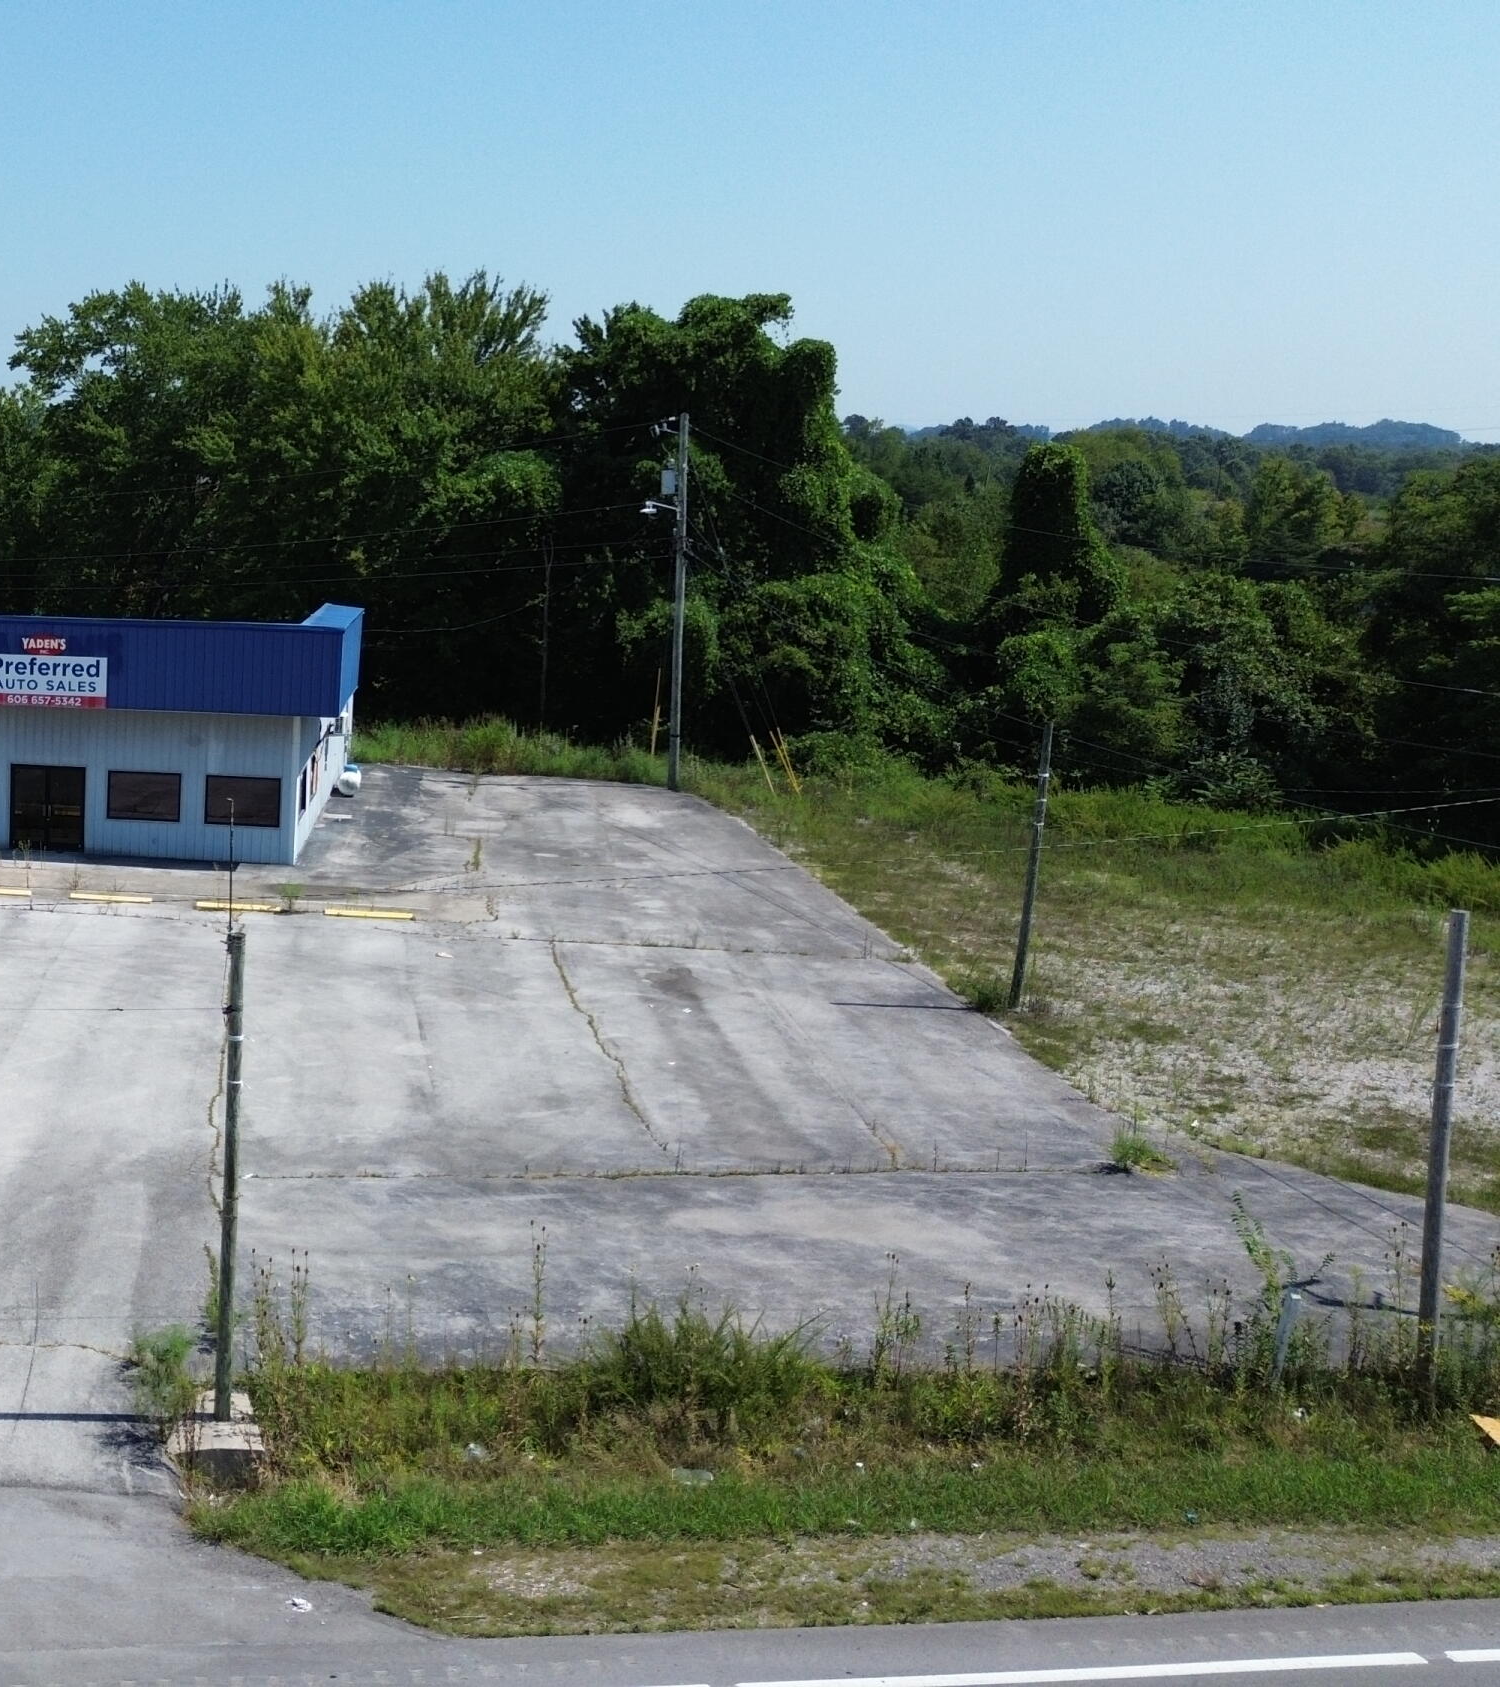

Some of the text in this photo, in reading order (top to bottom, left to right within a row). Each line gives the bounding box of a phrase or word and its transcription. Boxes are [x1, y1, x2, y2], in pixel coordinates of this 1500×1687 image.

[21, 637, 67, 650] YADEN'S
[46, 680, 97, 692] SALES
[7, 694, 82, 706] 606 657-5342
